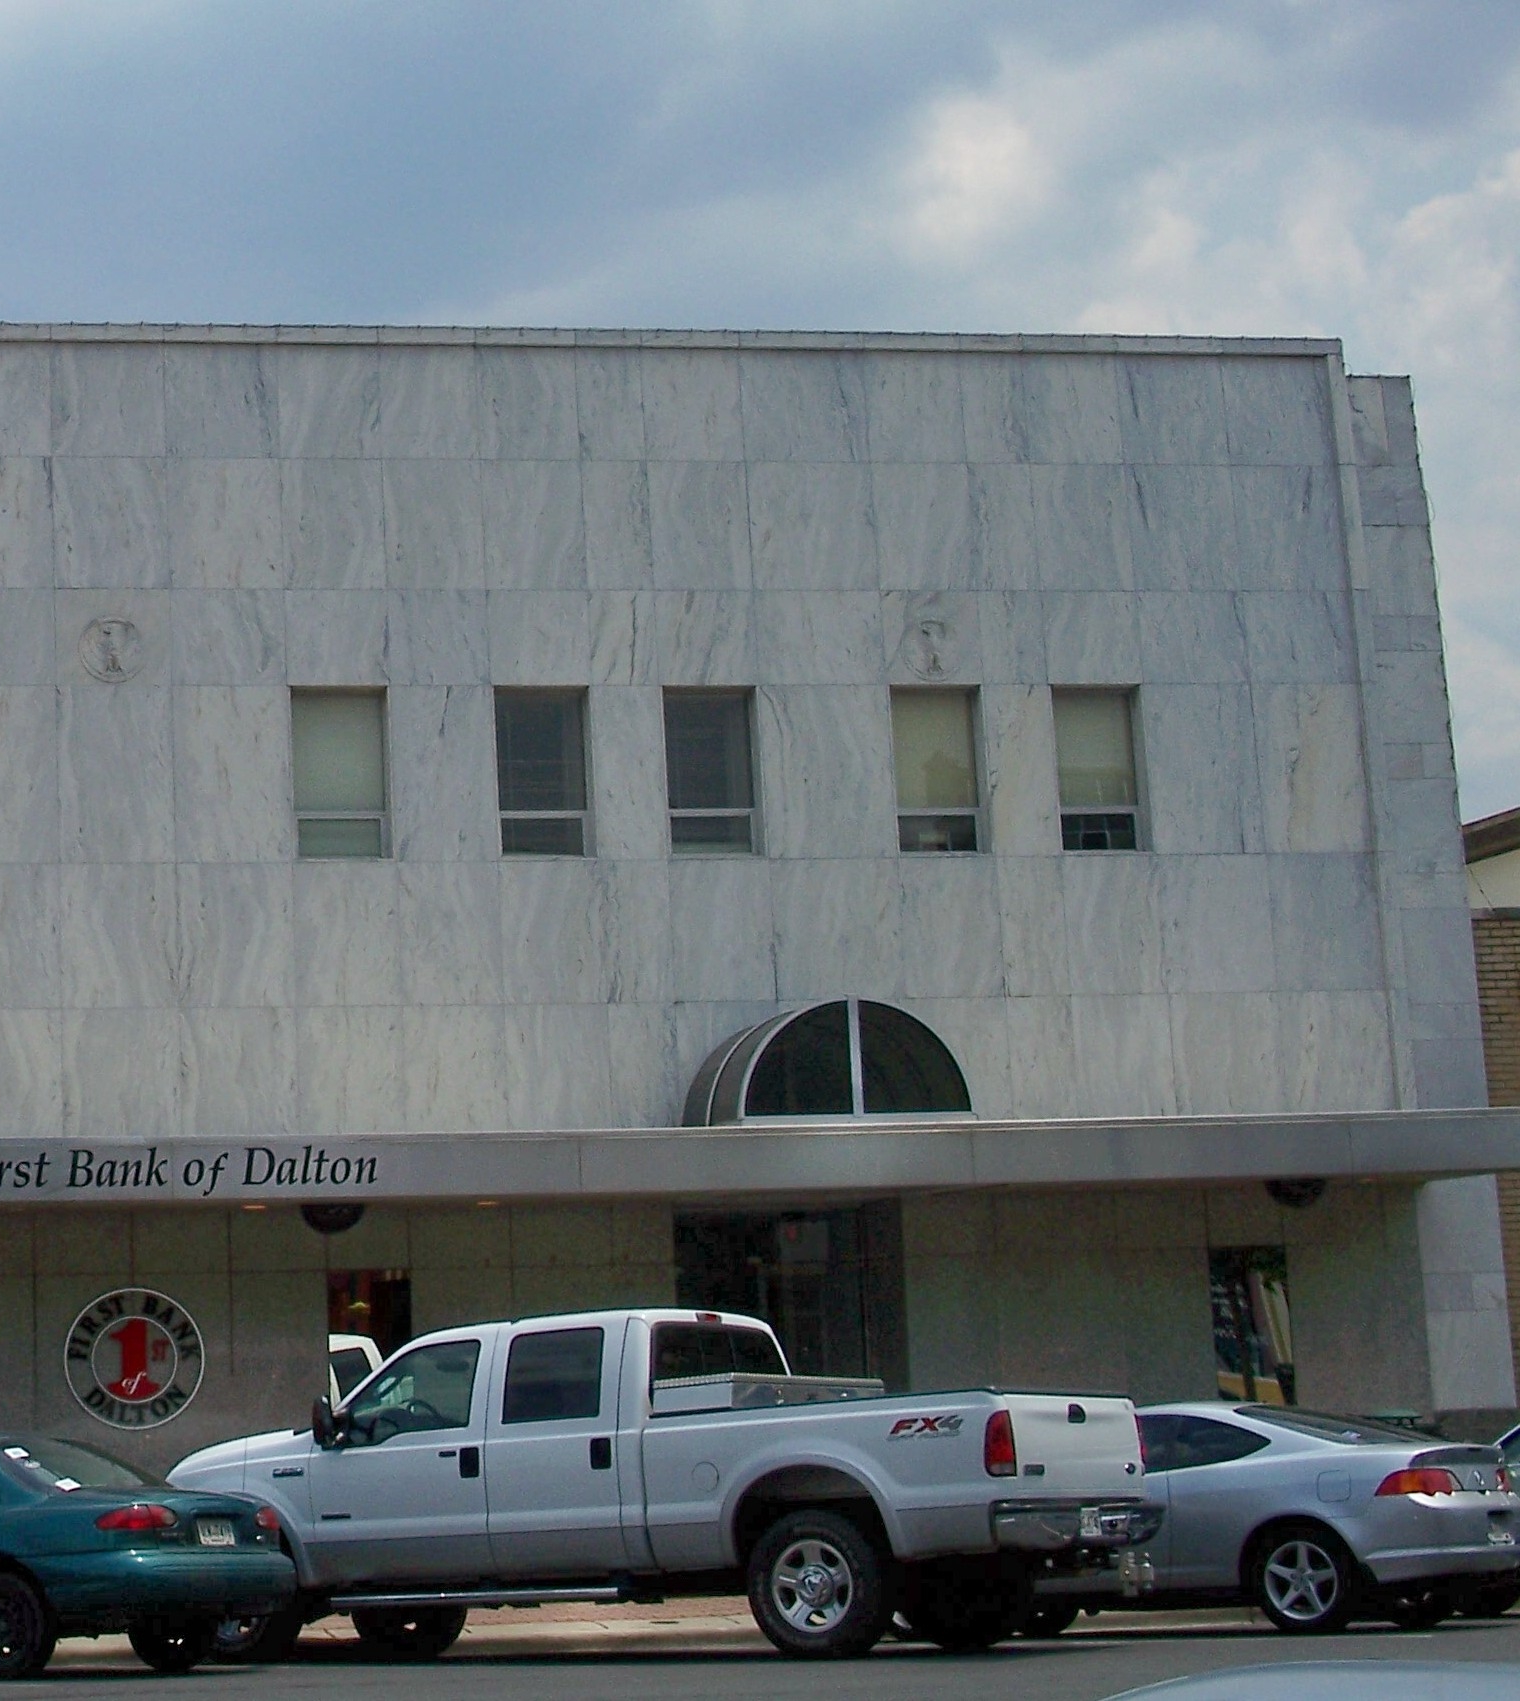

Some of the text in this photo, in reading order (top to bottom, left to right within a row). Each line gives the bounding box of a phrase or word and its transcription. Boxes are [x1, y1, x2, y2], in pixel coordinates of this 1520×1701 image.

[66, 1147, 168, 1187] Bank
[183, 1152, 229, 1197] of
[241, 1144, 378, 1186] Dalton
[68, 1294, 199, 1360] FIRST BANK
[121, 1370, 147, 1395] of
[84, 1384, 186, 1424] DALTON
[889, 1414, 964, 1434] FX4
